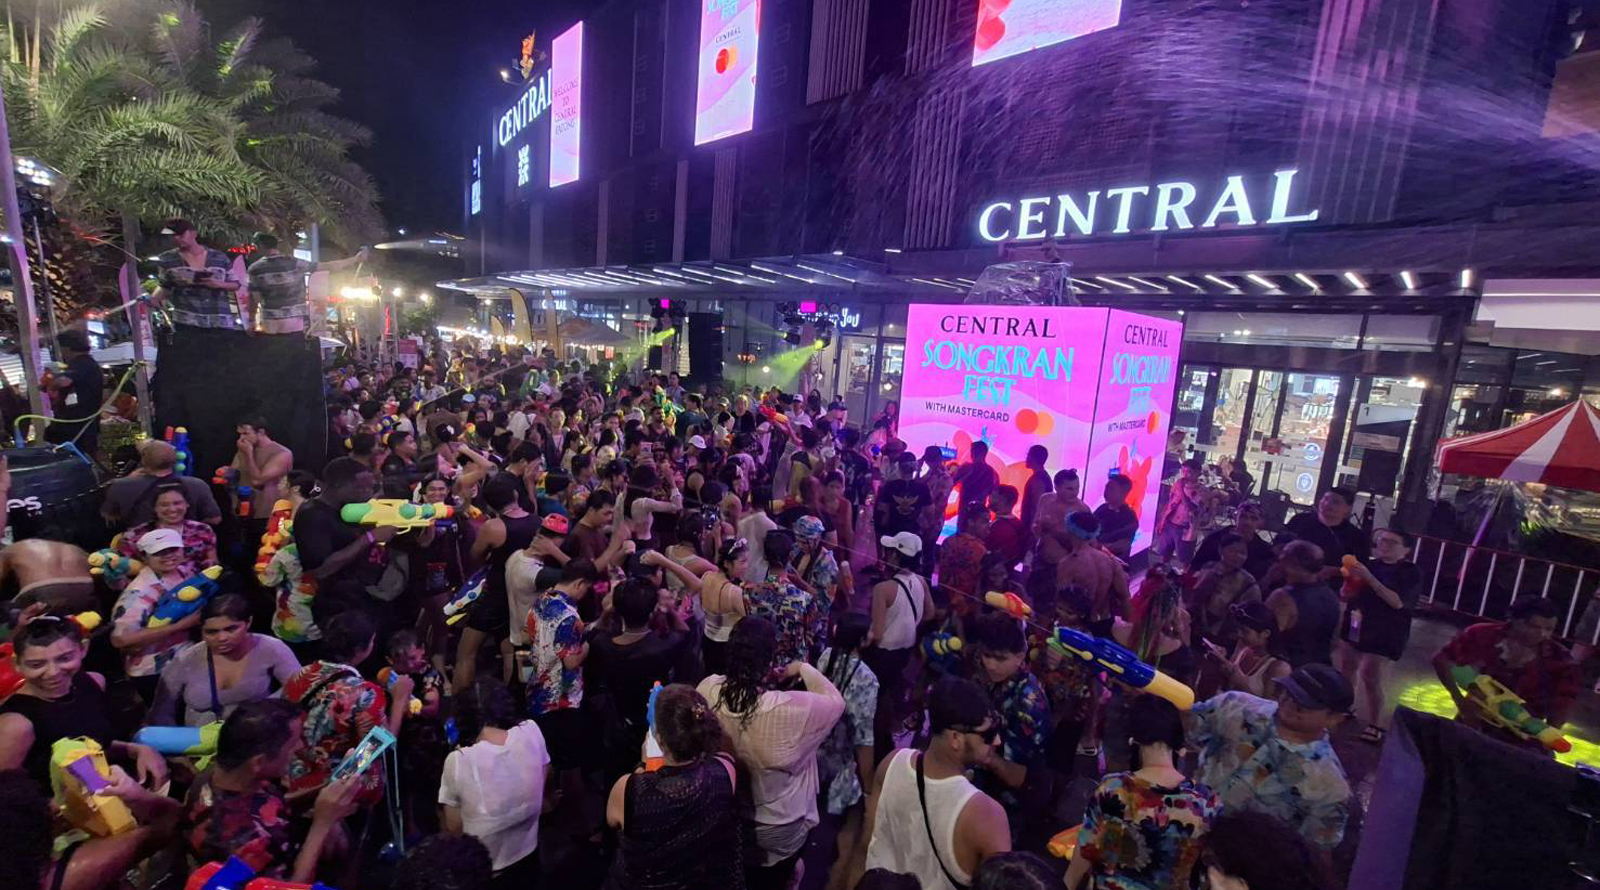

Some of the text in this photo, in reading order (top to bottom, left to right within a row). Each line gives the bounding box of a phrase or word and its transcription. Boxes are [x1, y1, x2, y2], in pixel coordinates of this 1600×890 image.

[978, 169, 1319, 242] CENTRAL
[940, 315, 1057, 339] CENTRAL
[1124, 324, 1168, 348] CENTRAL
[921, 339, 1075, 383] SONGKRAN
[1109, 352, 1172, 385] SONGKRAN
[962, 375, 1017, 407] FEST
[925, 401, 1010, 423] WITH MASTERCARD
